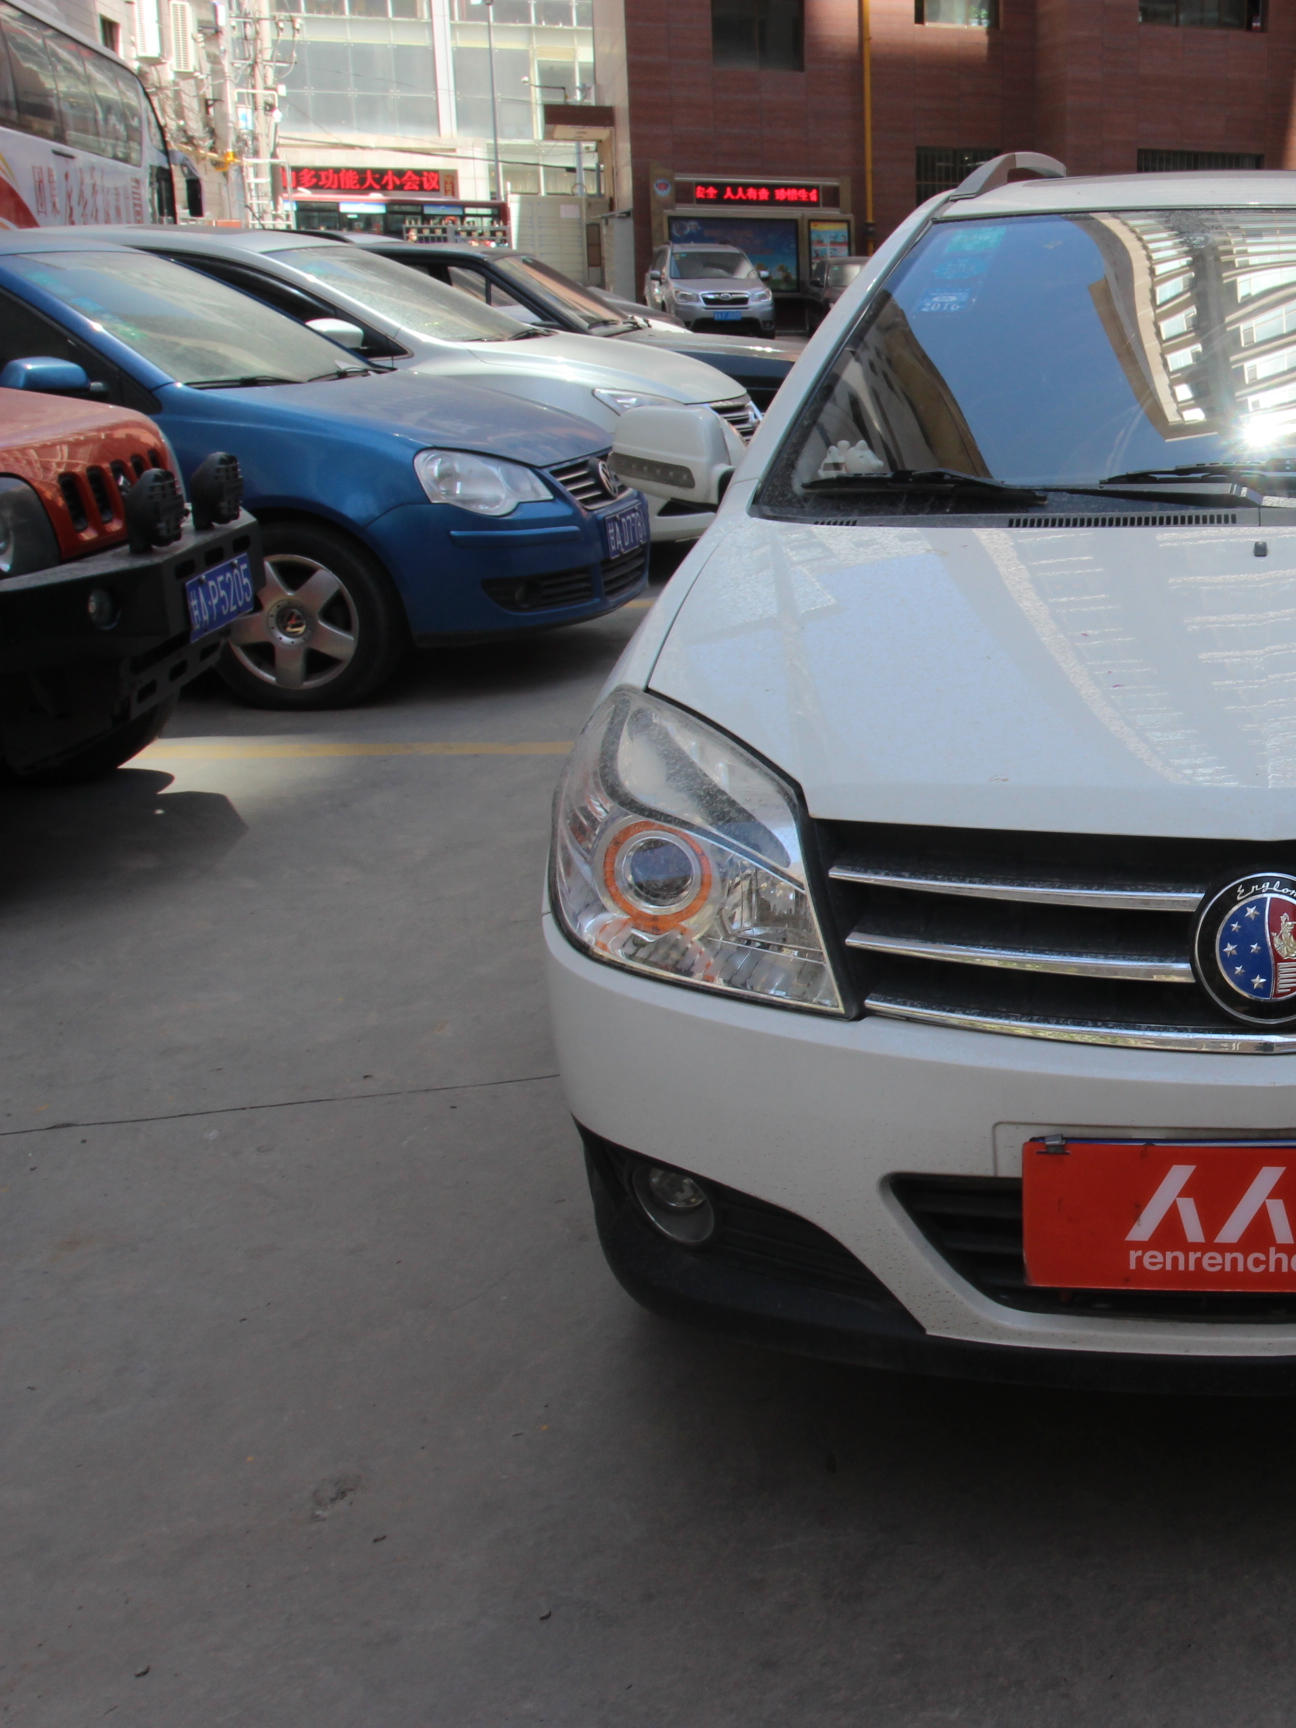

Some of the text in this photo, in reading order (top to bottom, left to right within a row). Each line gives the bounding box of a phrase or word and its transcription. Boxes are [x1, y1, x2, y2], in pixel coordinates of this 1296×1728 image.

[723, 186, 770, 201] 人人有责
[920, 302, 960, 312] 2016
